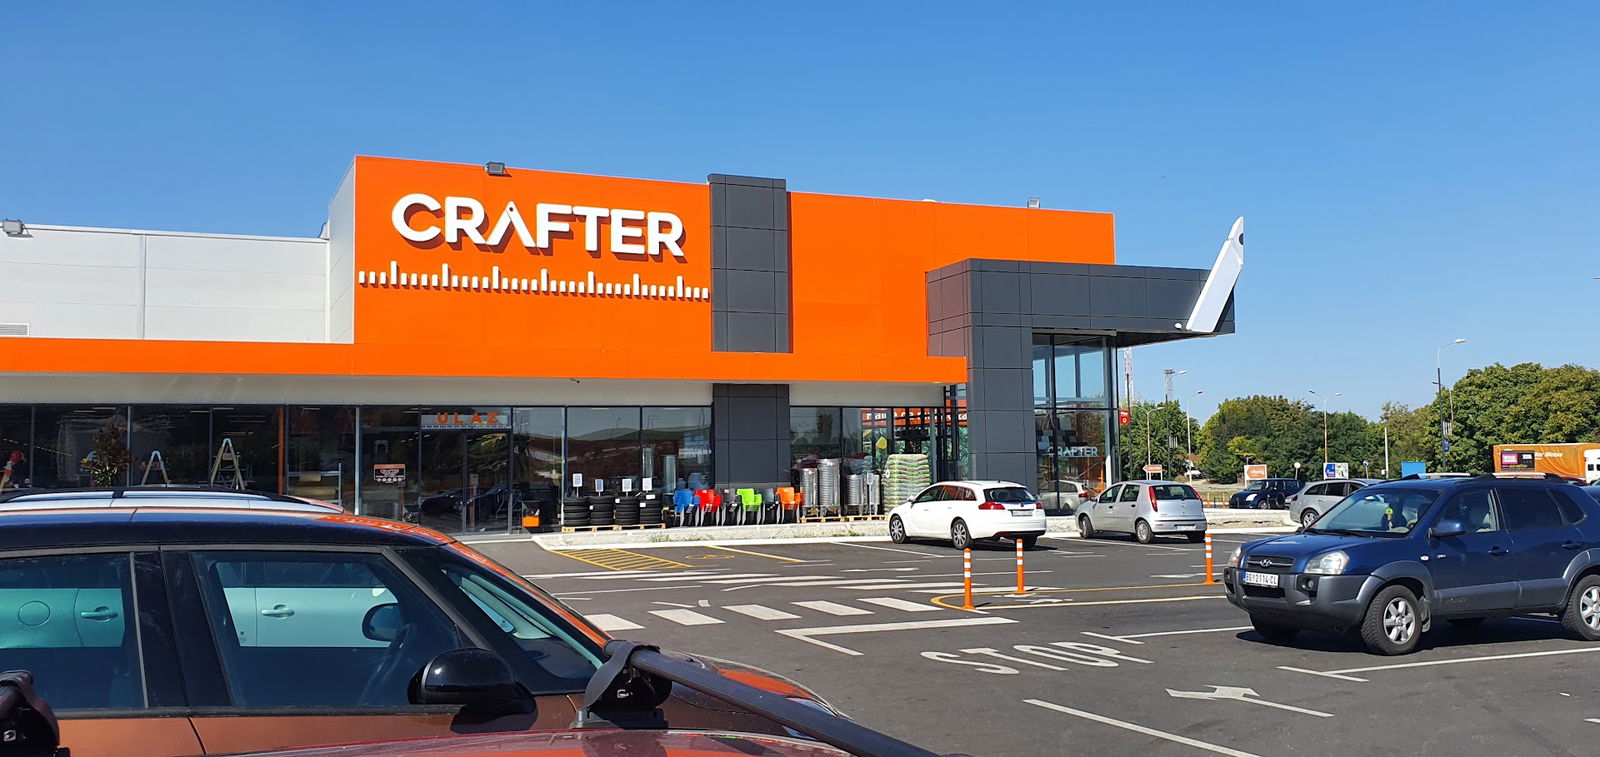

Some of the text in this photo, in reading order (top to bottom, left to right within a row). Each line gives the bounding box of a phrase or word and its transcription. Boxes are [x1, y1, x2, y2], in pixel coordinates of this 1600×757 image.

[391, 193, 685, 257] CRAFTER
[436, 411, 498, 424] ULAZ
[920, 642, 1155, 674] STOP
